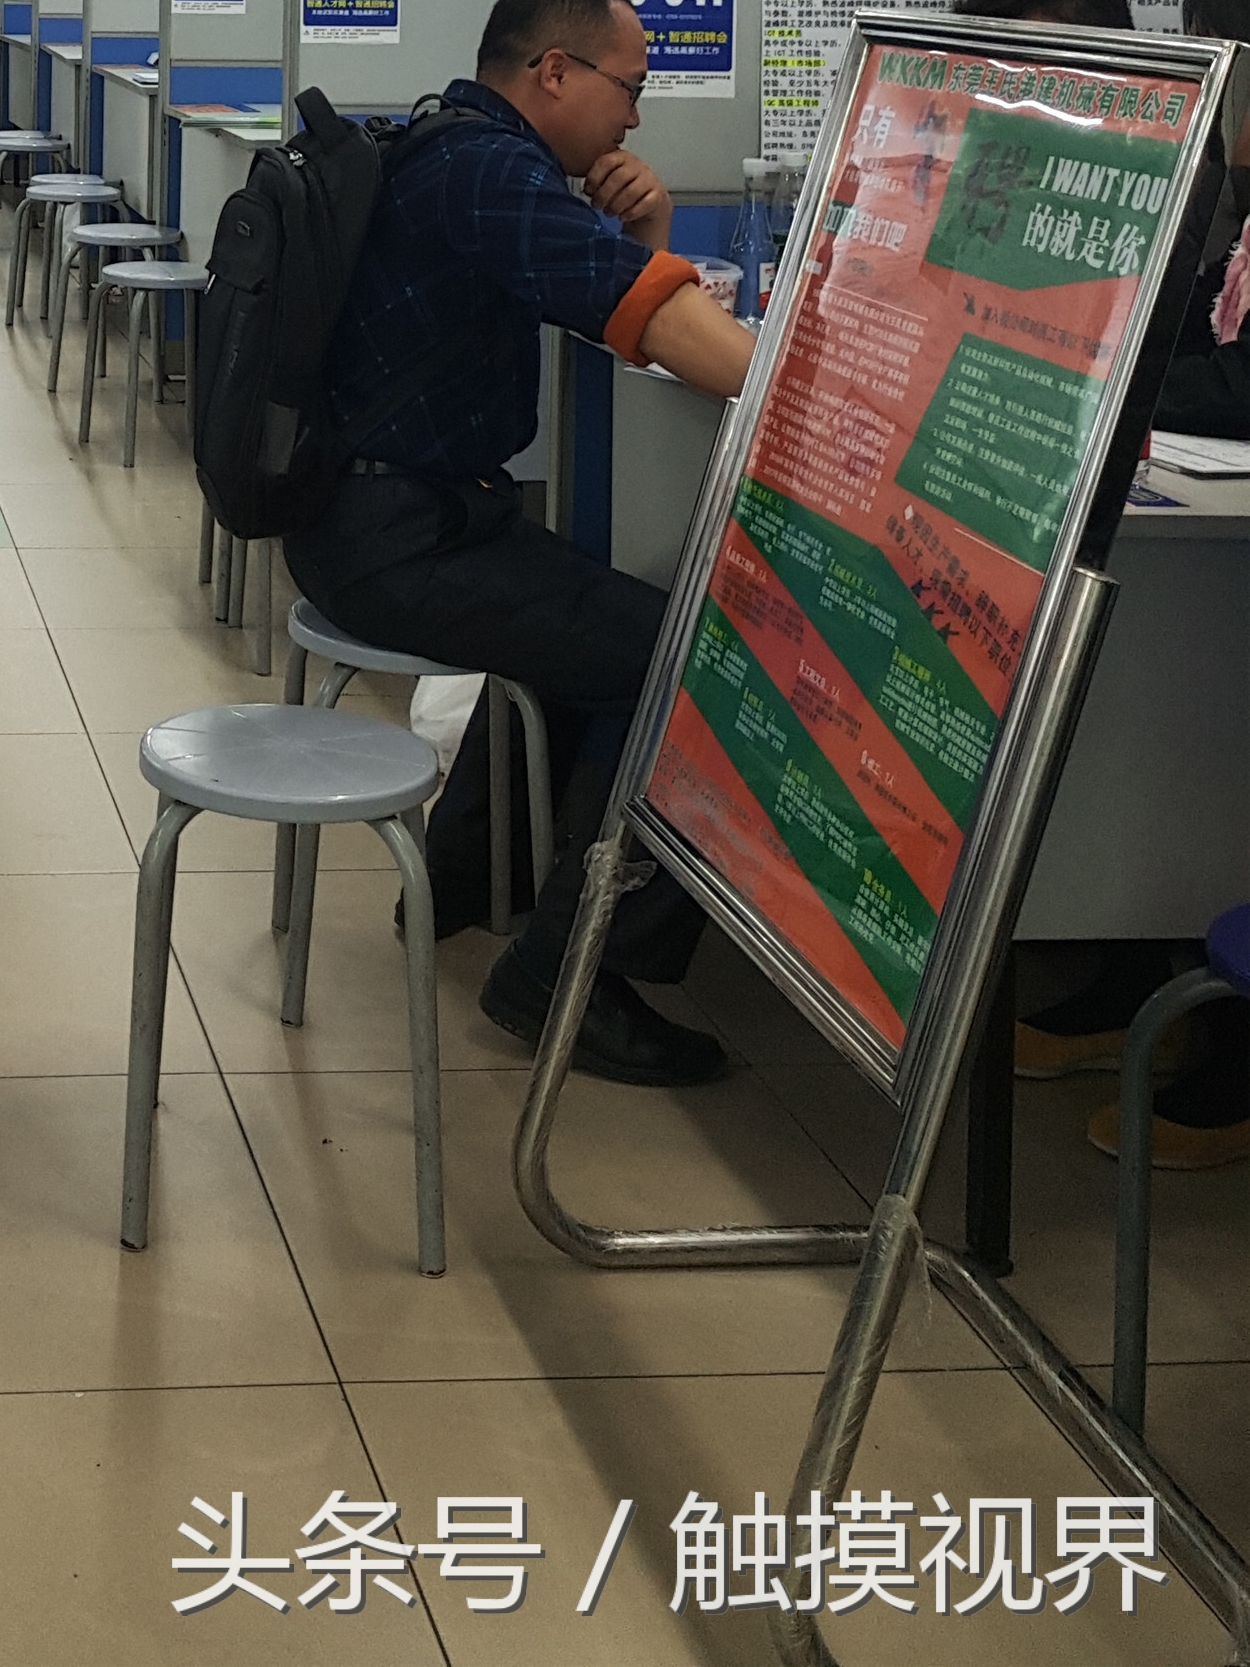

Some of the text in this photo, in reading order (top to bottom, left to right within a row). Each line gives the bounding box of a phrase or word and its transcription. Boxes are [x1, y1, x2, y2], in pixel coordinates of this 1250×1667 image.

[878, 51, 948, 91] WKKM
[764, 130, 819, 139] 公司地址：东莞
[1039, 155, 1169, 215] I WANT YOU
[1021, 202, 1147, 277] 的就是你
